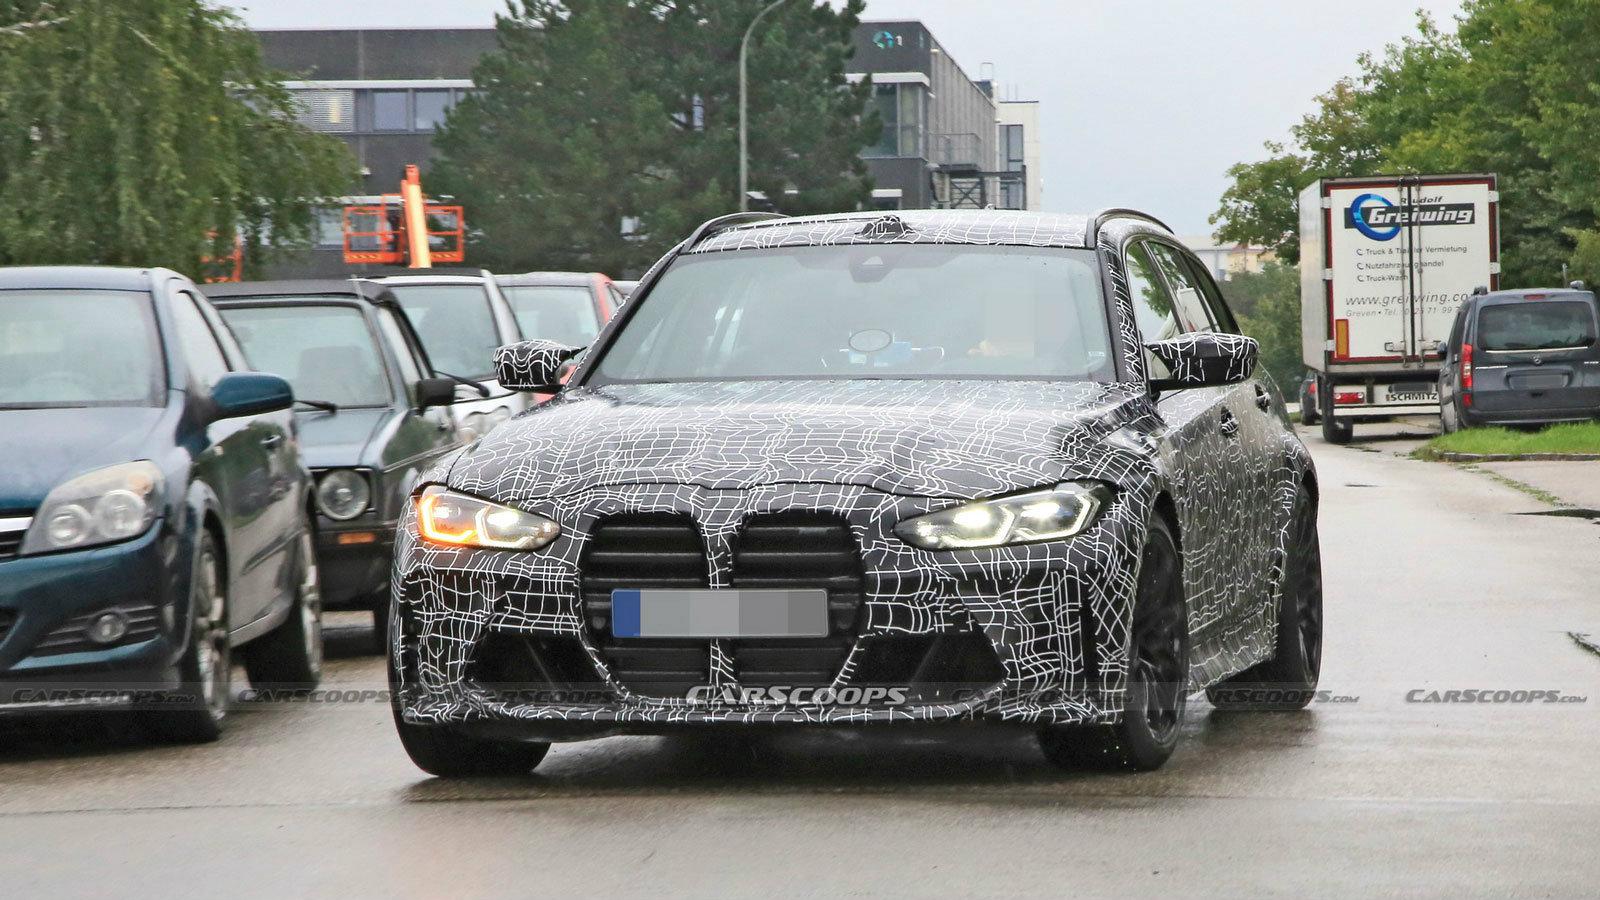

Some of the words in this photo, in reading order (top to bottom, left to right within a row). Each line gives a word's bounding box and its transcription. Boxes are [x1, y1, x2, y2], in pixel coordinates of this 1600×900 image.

[1400, 196, 1443, 204] Rudolf
[1368, 206, 1474, 224] Greiwing
[1425, 246, 1468, 254] Vermietung
